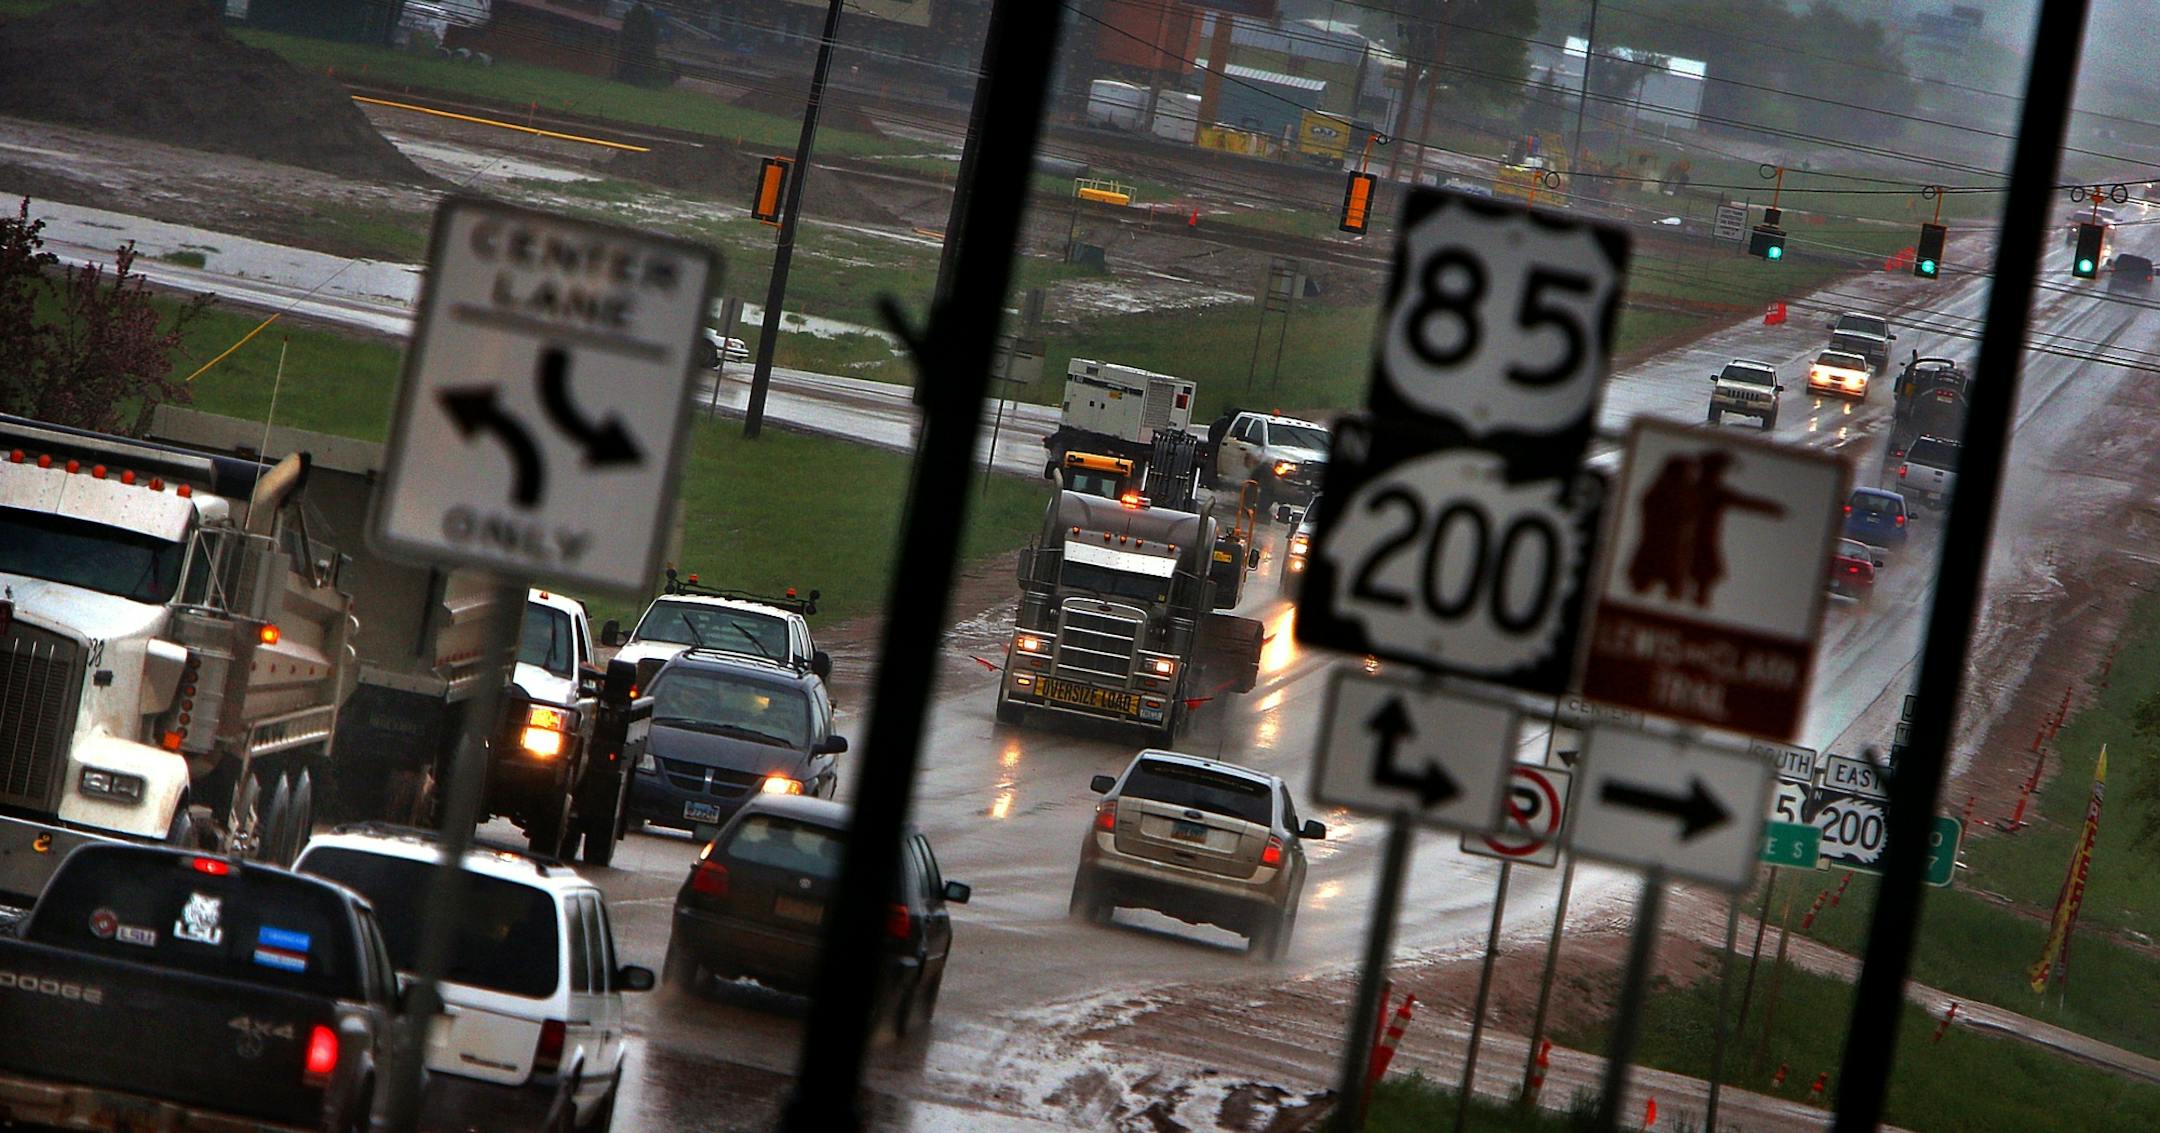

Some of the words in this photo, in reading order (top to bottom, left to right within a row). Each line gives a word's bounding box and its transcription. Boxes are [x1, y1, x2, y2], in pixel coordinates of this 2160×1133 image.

[470, 221, 681, 291] CENTER
[493, 270, 629, 328] LANE
[1407, 249, 1592, 385] 85
[442, 503, 593, 562] ONLY
[1352, 490, 1557, 634] 200
[1042, 679, 1097, 706] OVERSIZE
[1101, 690, 1131, 712] LOAD
[1777, 794, 1796, 823] 5
[1822, 806, 1882, 850] 200
[120, 929, 154, 945] LSU
[173, 919, 223, 946] LSU
[0, 972, 103, 1004] DODGE
